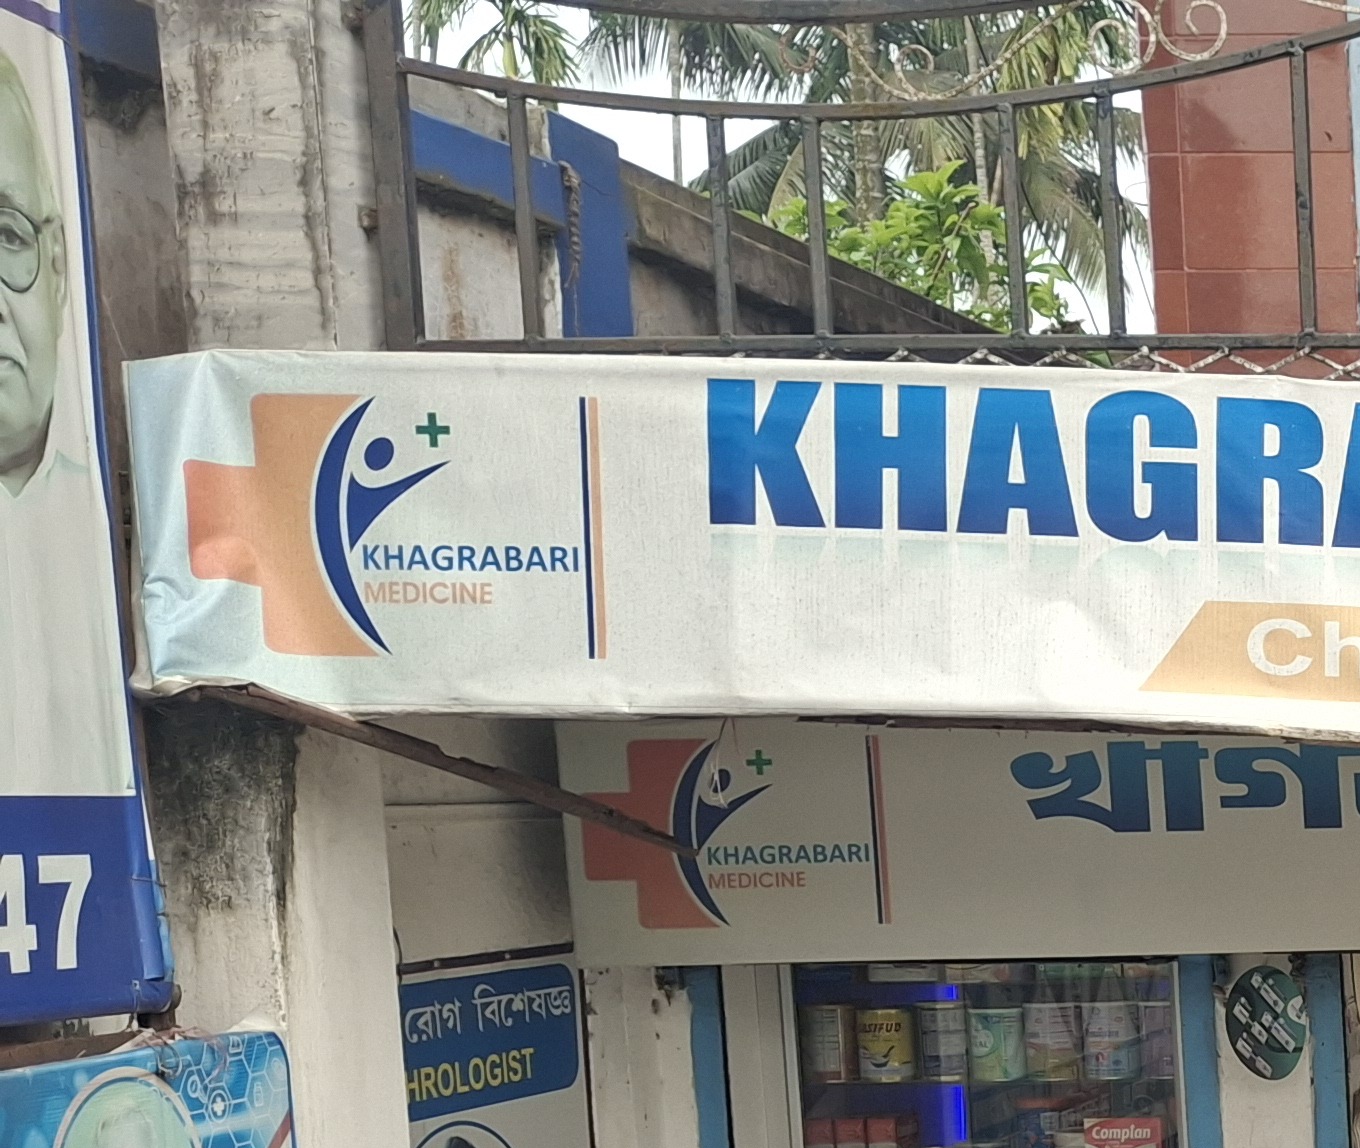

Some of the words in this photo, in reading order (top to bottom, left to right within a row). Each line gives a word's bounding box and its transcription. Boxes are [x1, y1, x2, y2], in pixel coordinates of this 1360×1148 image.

[361, 543, 580, 575] KHAGRABARI
[363, 580, 494, 606] MEDICINE
[706, 843, 870, 866] KHAGRABARI
[708, 870, 807, 889] MEDICINE
[404, 997, 462, 1044] রোগ
[472, 983, 573, 1033] বিশেষজ্ঞ
[404, 1046, 536, 1103] HROLOGIST
[1091, 1123, 1152, 1142] Complan
